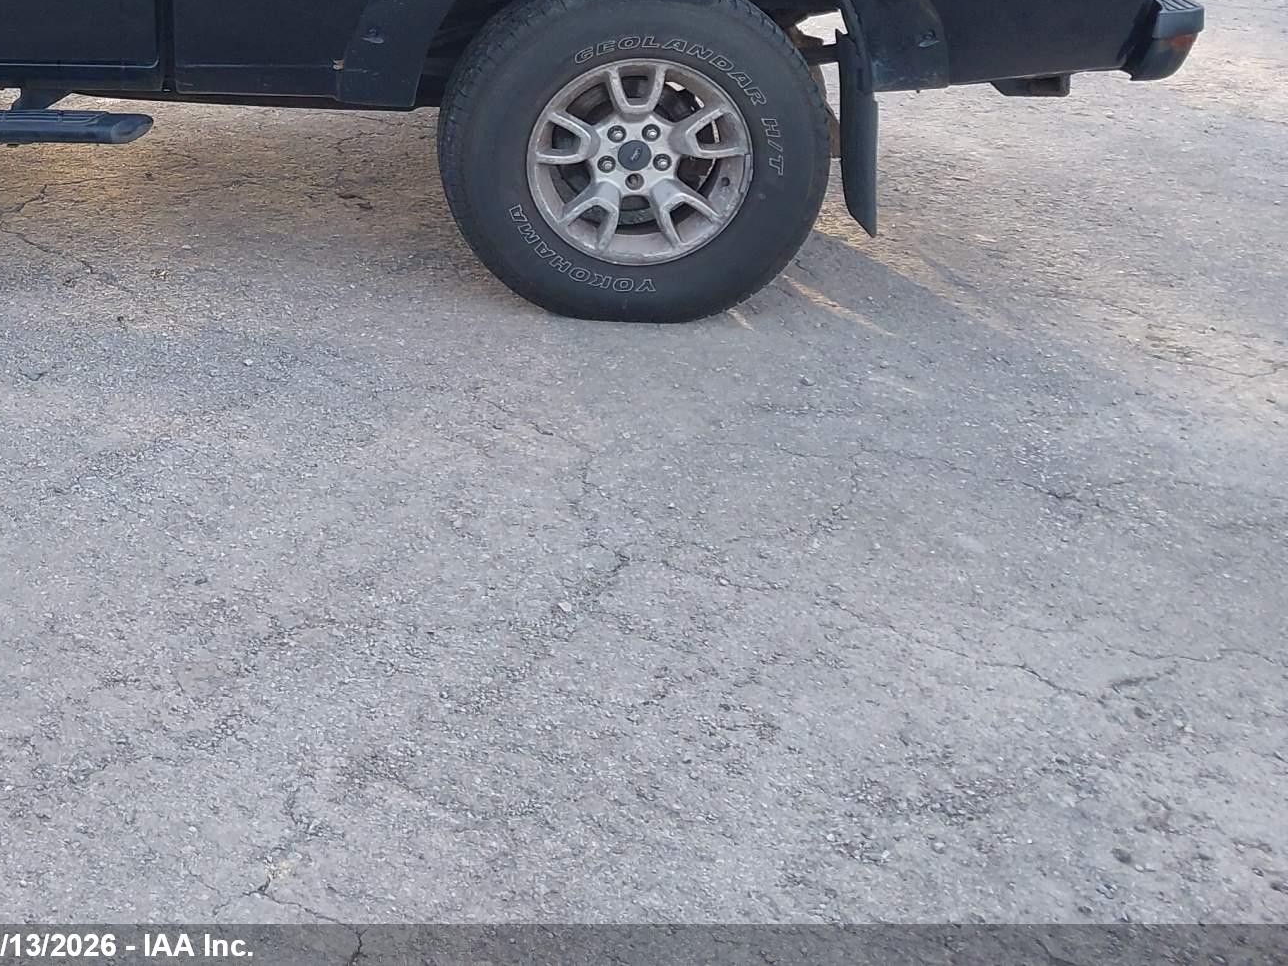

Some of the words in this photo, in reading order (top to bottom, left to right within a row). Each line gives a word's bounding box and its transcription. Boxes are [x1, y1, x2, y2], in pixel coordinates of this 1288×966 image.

[574, 35, 768, 107] GEOLANDAR
[761, 116, 785, 176] H/T
[508, 203, 657, 294] YOKOHAMA
